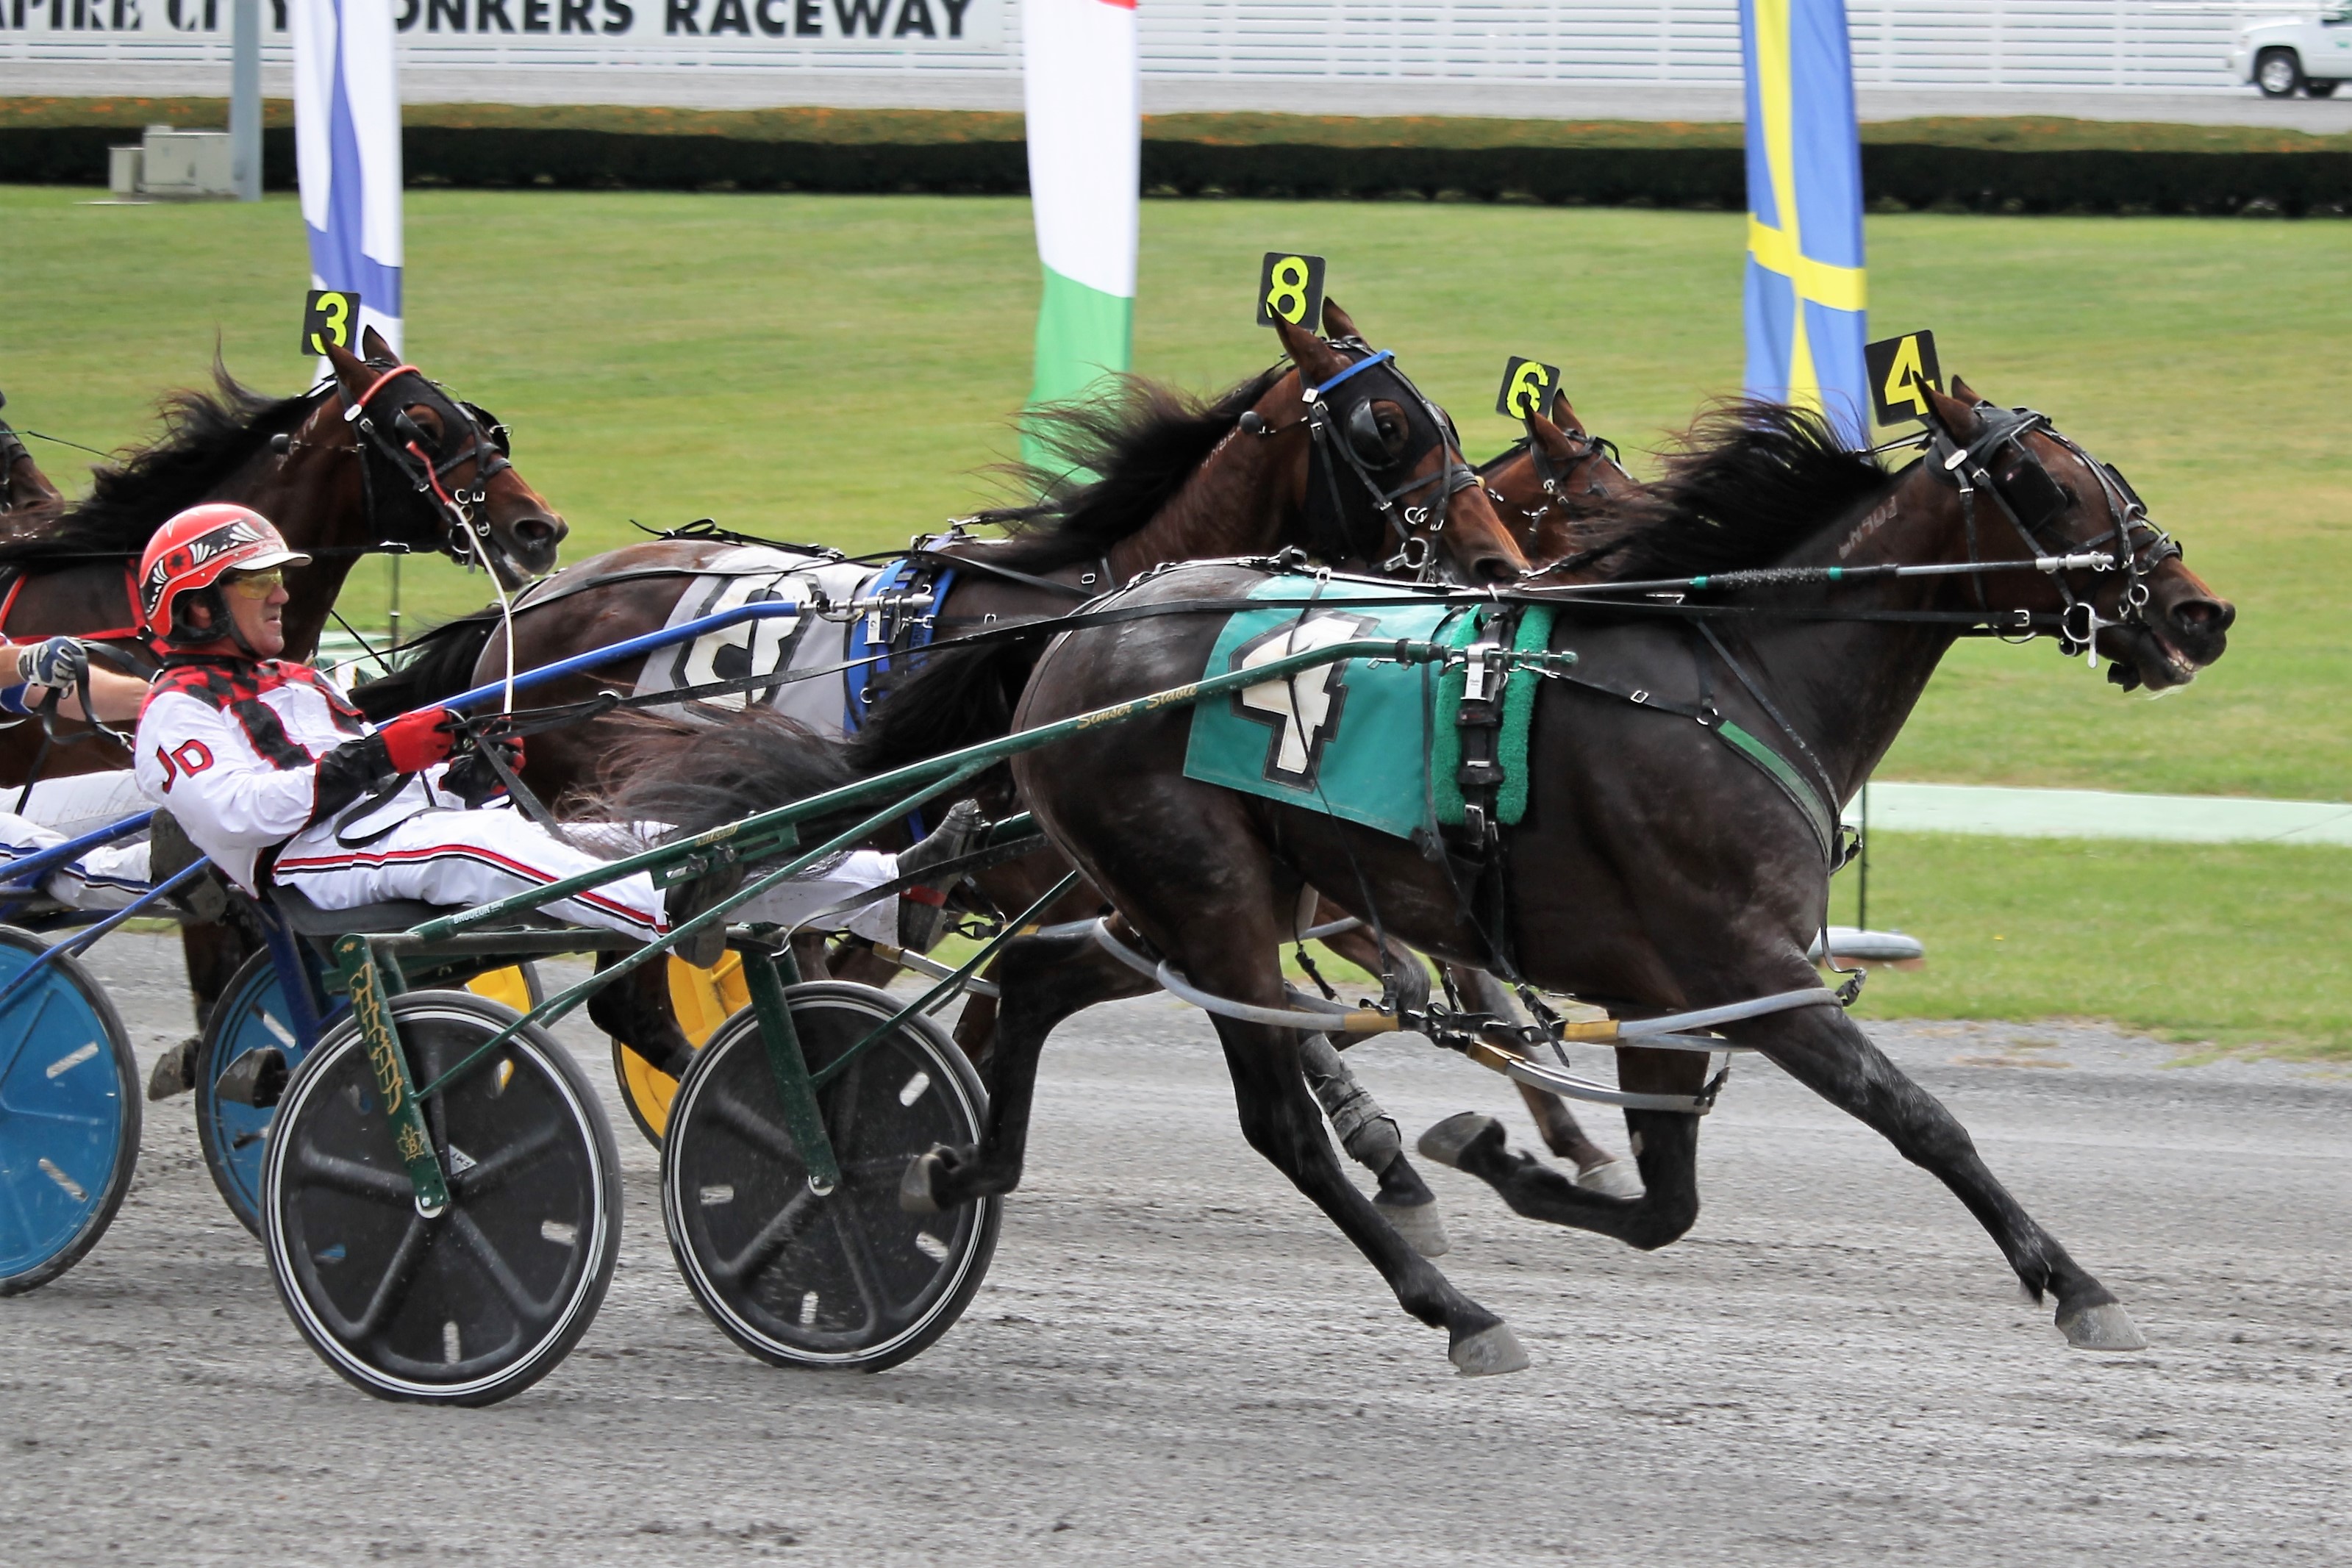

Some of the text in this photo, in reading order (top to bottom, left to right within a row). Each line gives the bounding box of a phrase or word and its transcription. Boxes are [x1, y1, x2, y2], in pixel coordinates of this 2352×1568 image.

[0, 0, 142, 31] PIRE
[395, 0, 634, 36] ONKERS
[665, 0, 973, 39] RACEWAY
[1266, 256, 1309, 325] 8
[310, 292, 348, 355] 3
[1506, 361, 1548, 420] 6
[1884, 334, 1936, 415] 4
[1240, 615, 1362, 776] 4
[156, 739, 214, 795] JD
